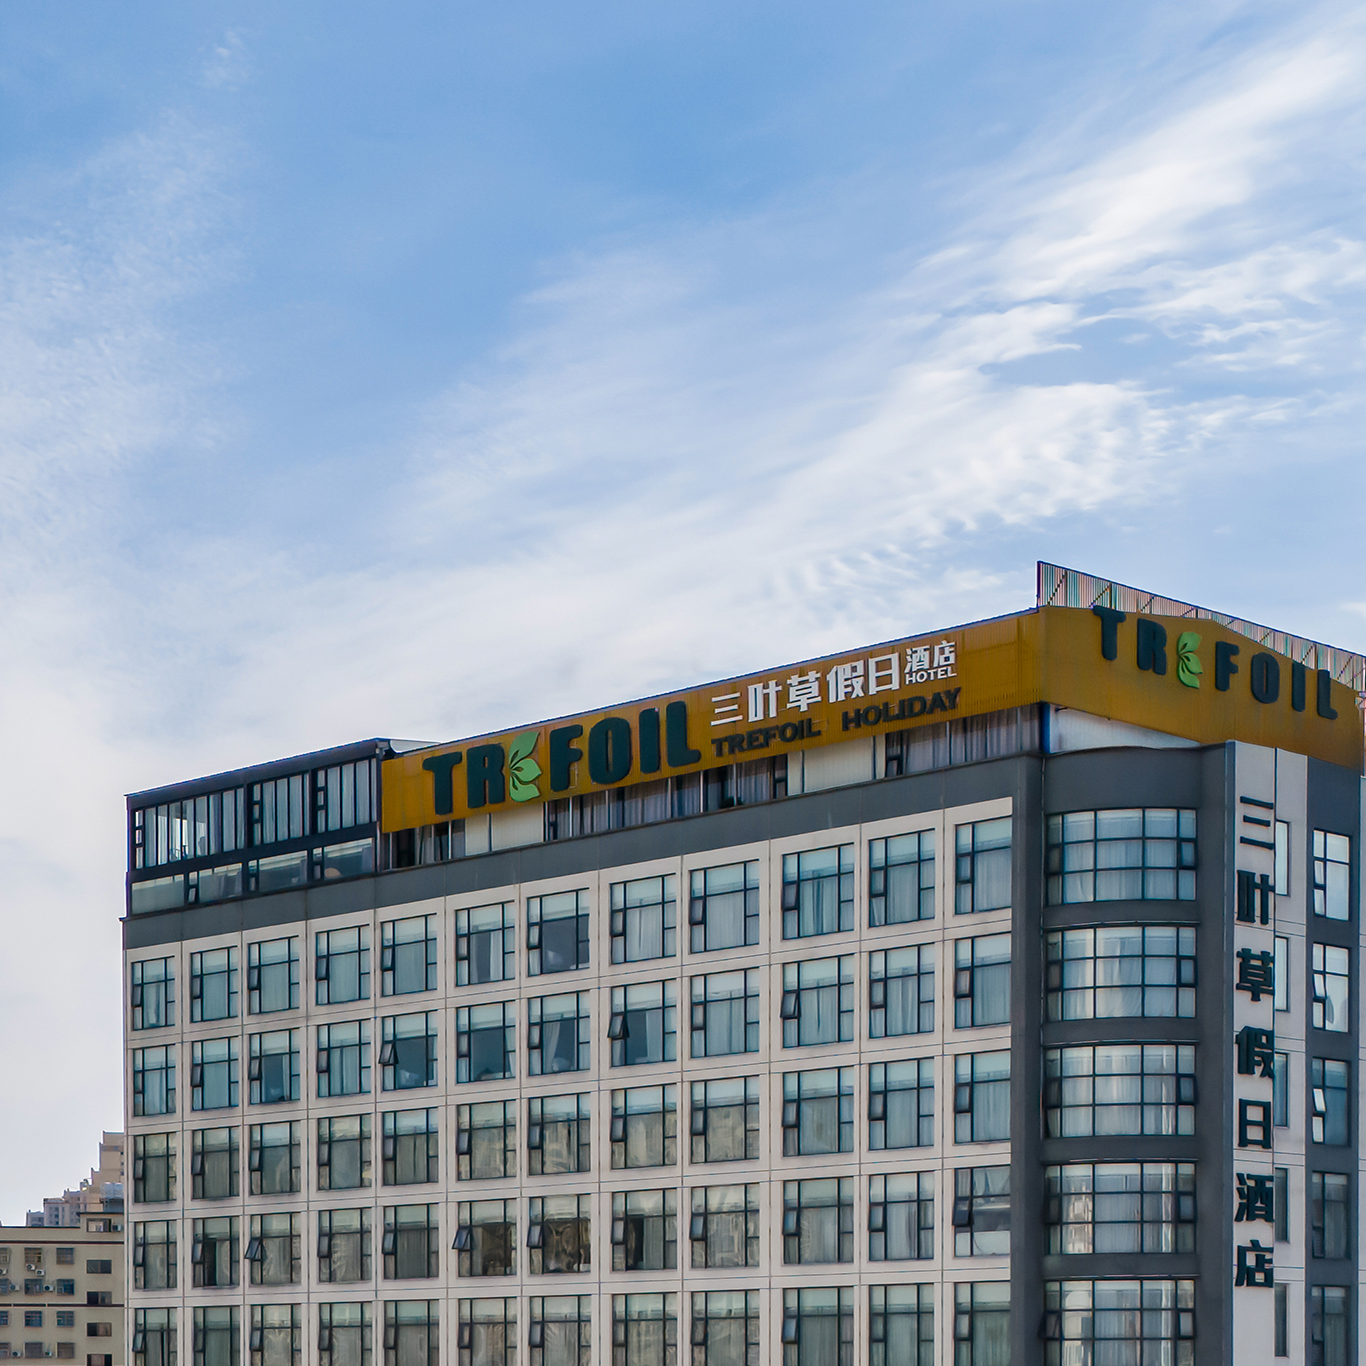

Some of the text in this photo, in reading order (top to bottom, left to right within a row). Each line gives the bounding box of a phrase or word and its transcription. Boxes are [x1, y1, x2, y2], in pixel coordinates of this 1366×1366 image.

[904, 667, 957, 685] HOTEL
[1093, 605, 1339, 720] TREFOIL
[422, 699, 701, 816] TREFOIL
[711, 686, 962, 759] TREFOIL HOLIDAY
[1235, 795, 1276, 1289] 三叶草假日酒店
